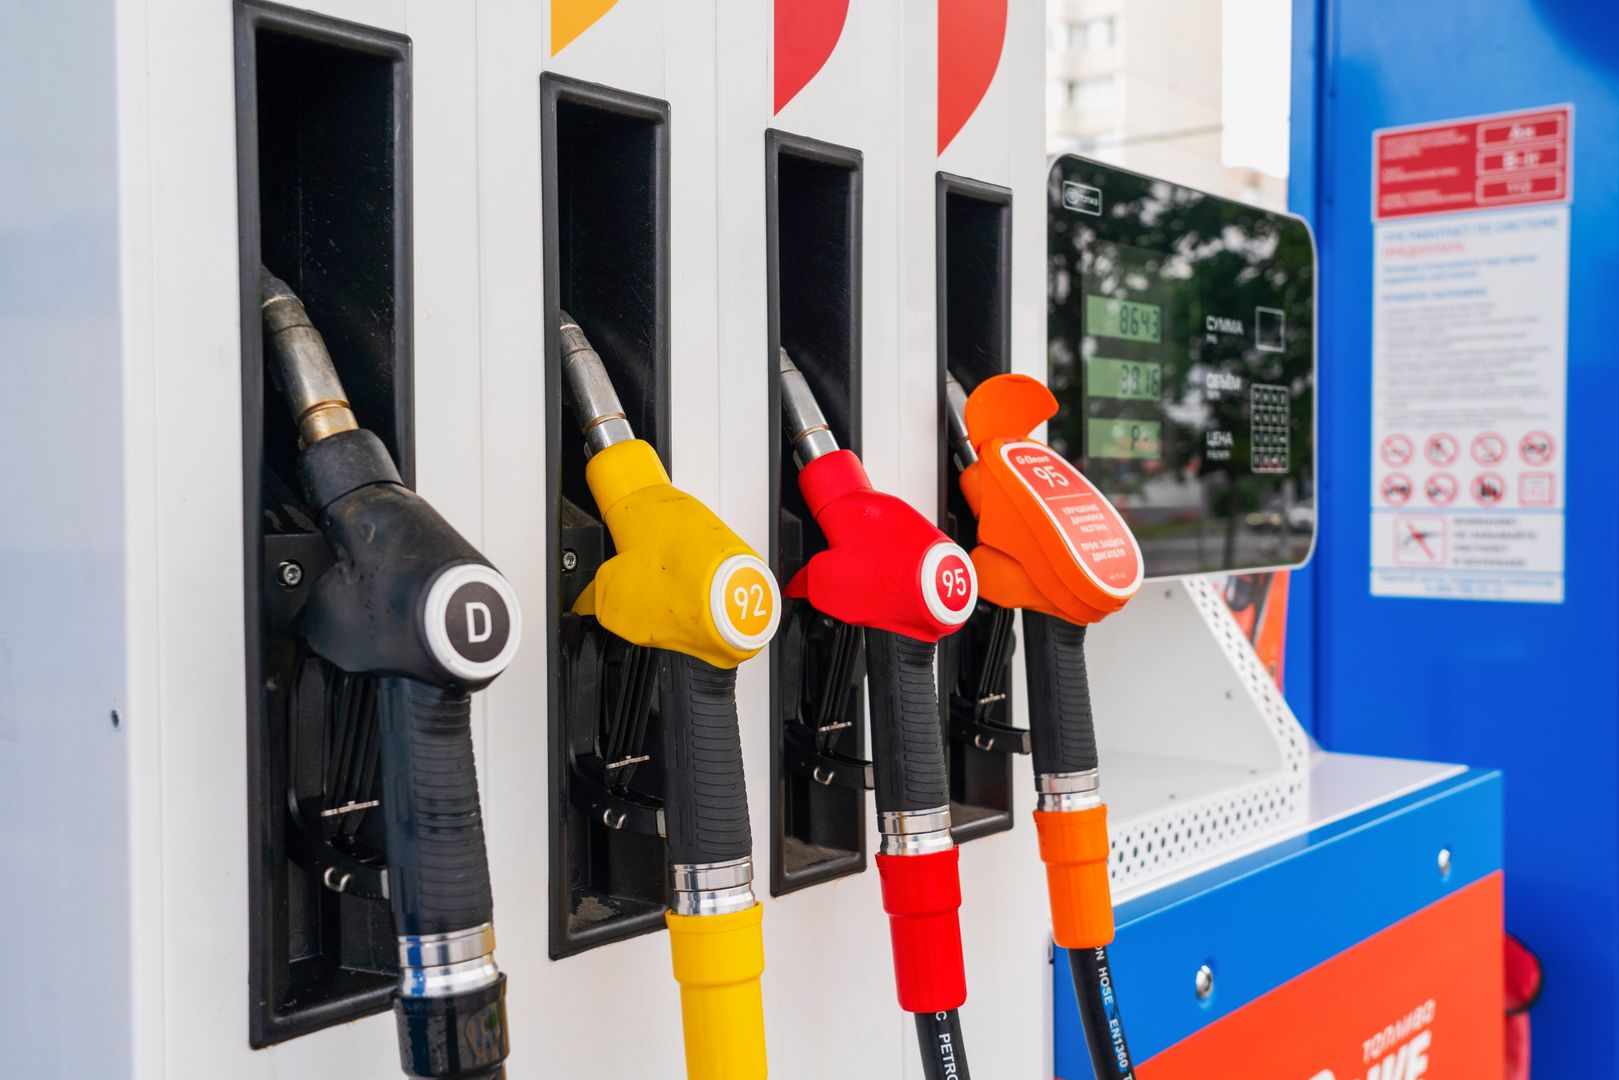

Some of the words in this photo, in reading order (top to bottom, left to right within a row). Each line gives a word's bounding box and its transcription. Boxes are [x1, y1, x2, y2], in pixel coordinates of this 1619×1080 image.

[1206, 432, 1234, 448] ЦЕНА
[1032, 465, 1069, 488] 95
[942, 568, 967, 598] 95
[734, 584, 766, 620] 92
[465, 601, 492, 643] D
[1098, 966, 1114, 1005] HOSE
[1109, 1019, 1129, 1068] EN1360
